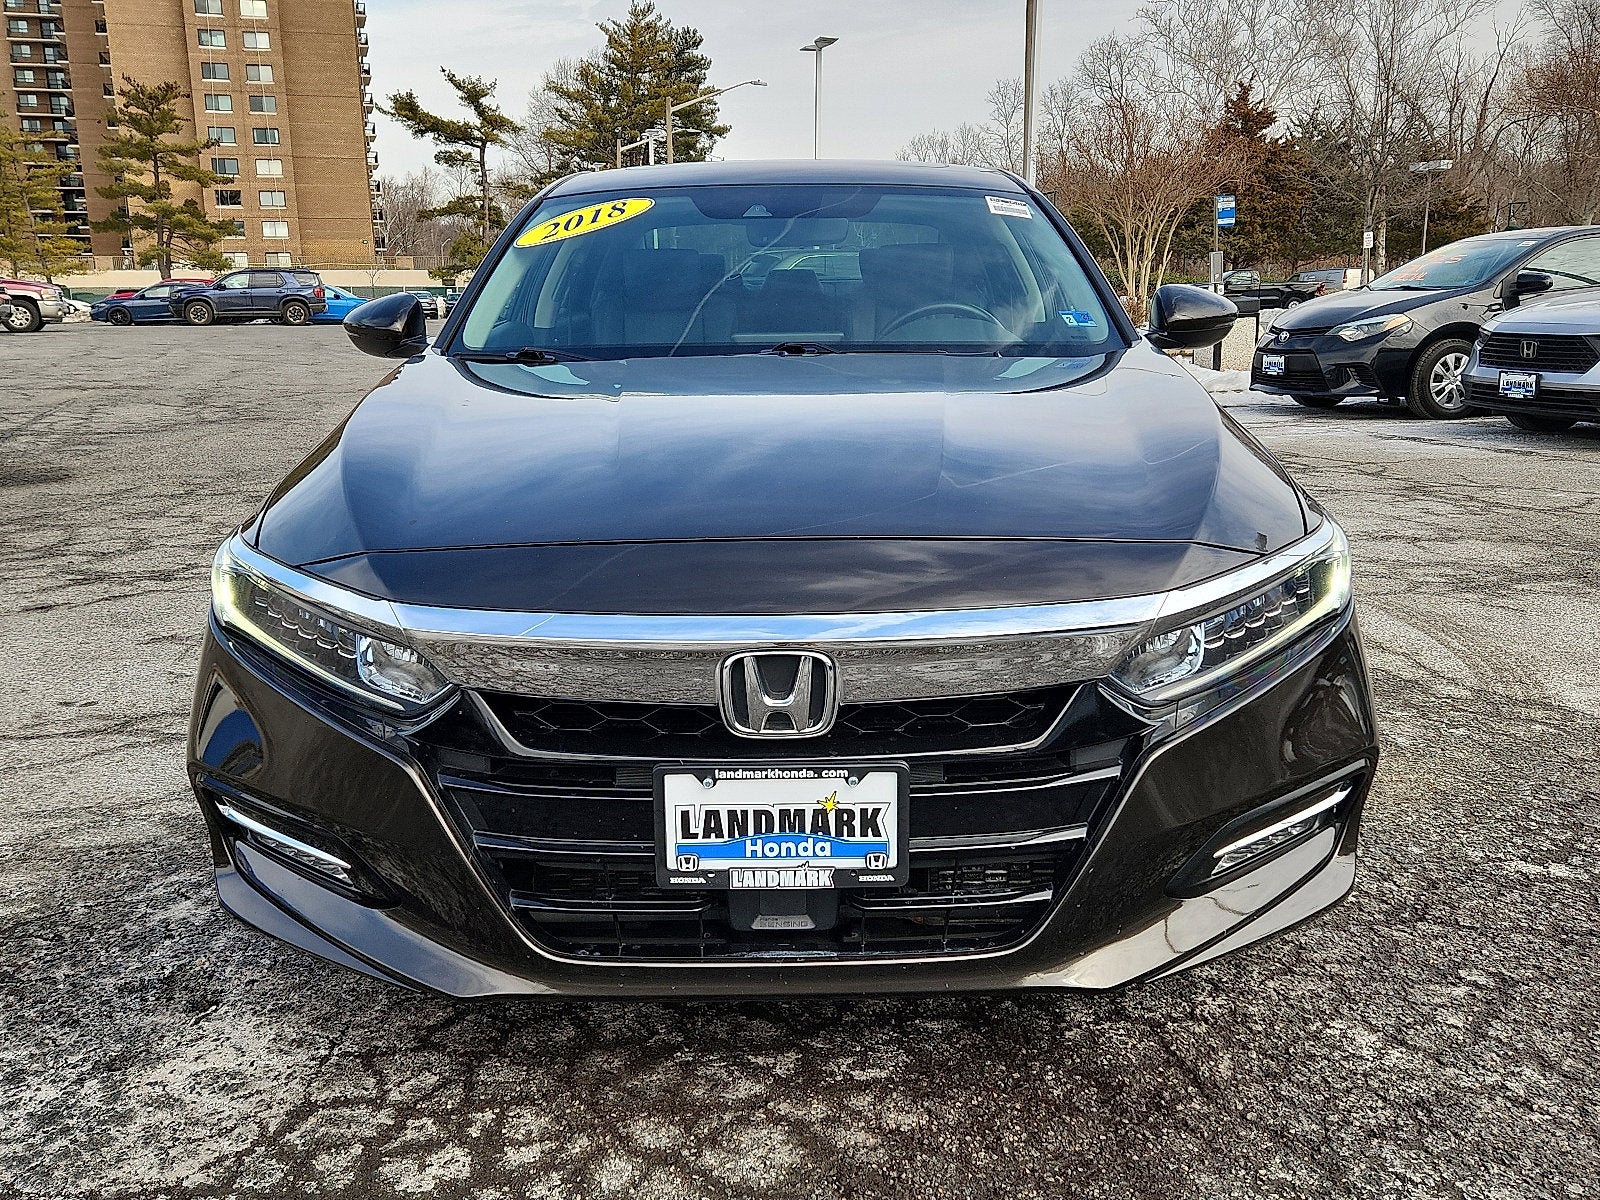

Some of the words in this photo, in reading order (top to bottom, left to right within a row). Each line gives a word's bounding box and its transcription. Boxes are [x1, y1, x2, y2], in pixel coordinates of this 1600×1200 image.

[541, 202, 627, 240] 2018
[680, 808, 882, 839] LANDMARK
[745, 838, 832, 857] Honda
[731, 868, 832, 888] LANDMARK
